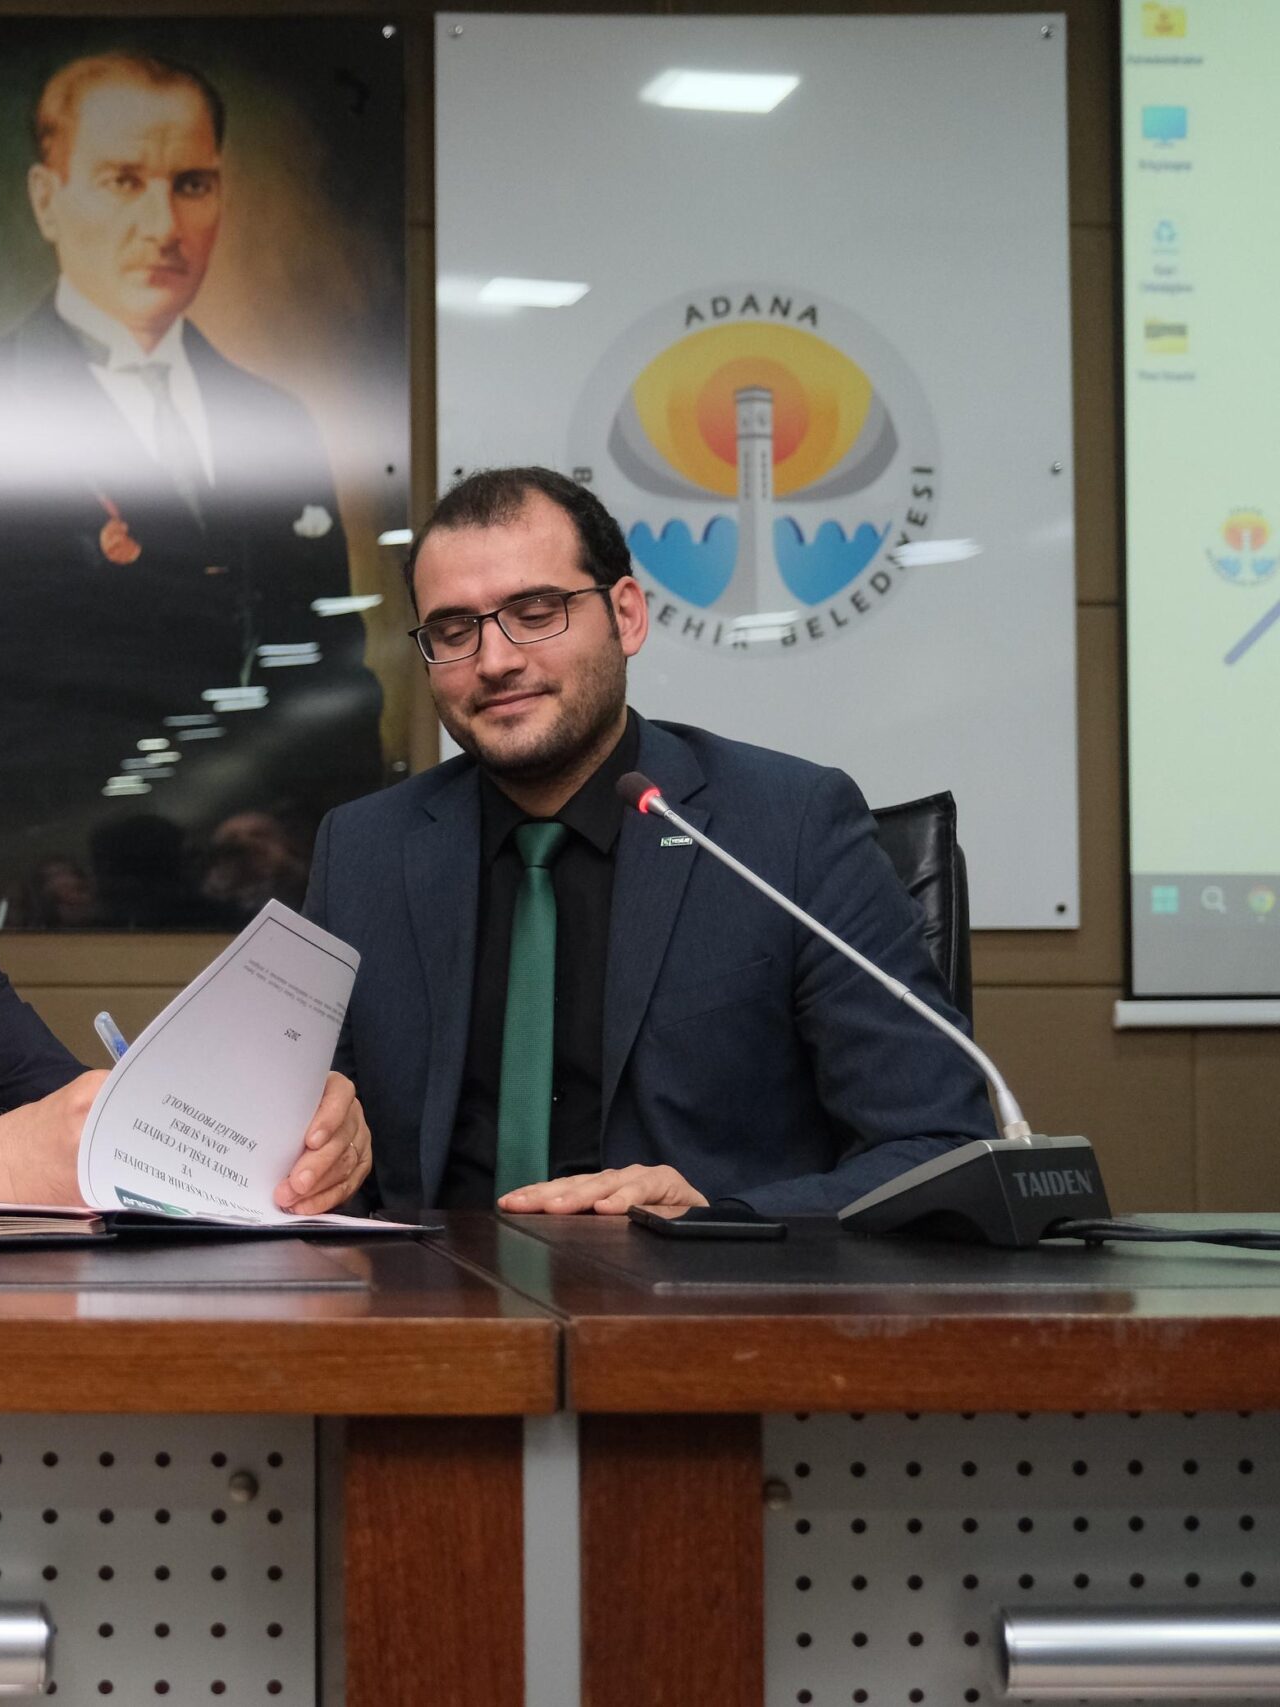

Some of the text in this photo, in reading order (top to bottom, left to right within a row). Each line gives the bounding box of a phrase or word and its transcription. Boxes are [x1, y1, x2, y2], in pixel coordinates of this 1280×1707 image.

[685, 293, 818, 328] ADANA
[132, 1117, 176, 1148] CEMİYETİ
[201, 1134, 230, 1156] ADANA
[114, 1148, 166, 1182] BELEDİYESİ
[176, 1141, 212, 1168] YEŞİLAY
[181, 1164, 192, 1177] VE
[1013, 1170, 1094, 1198] TAIDEN
